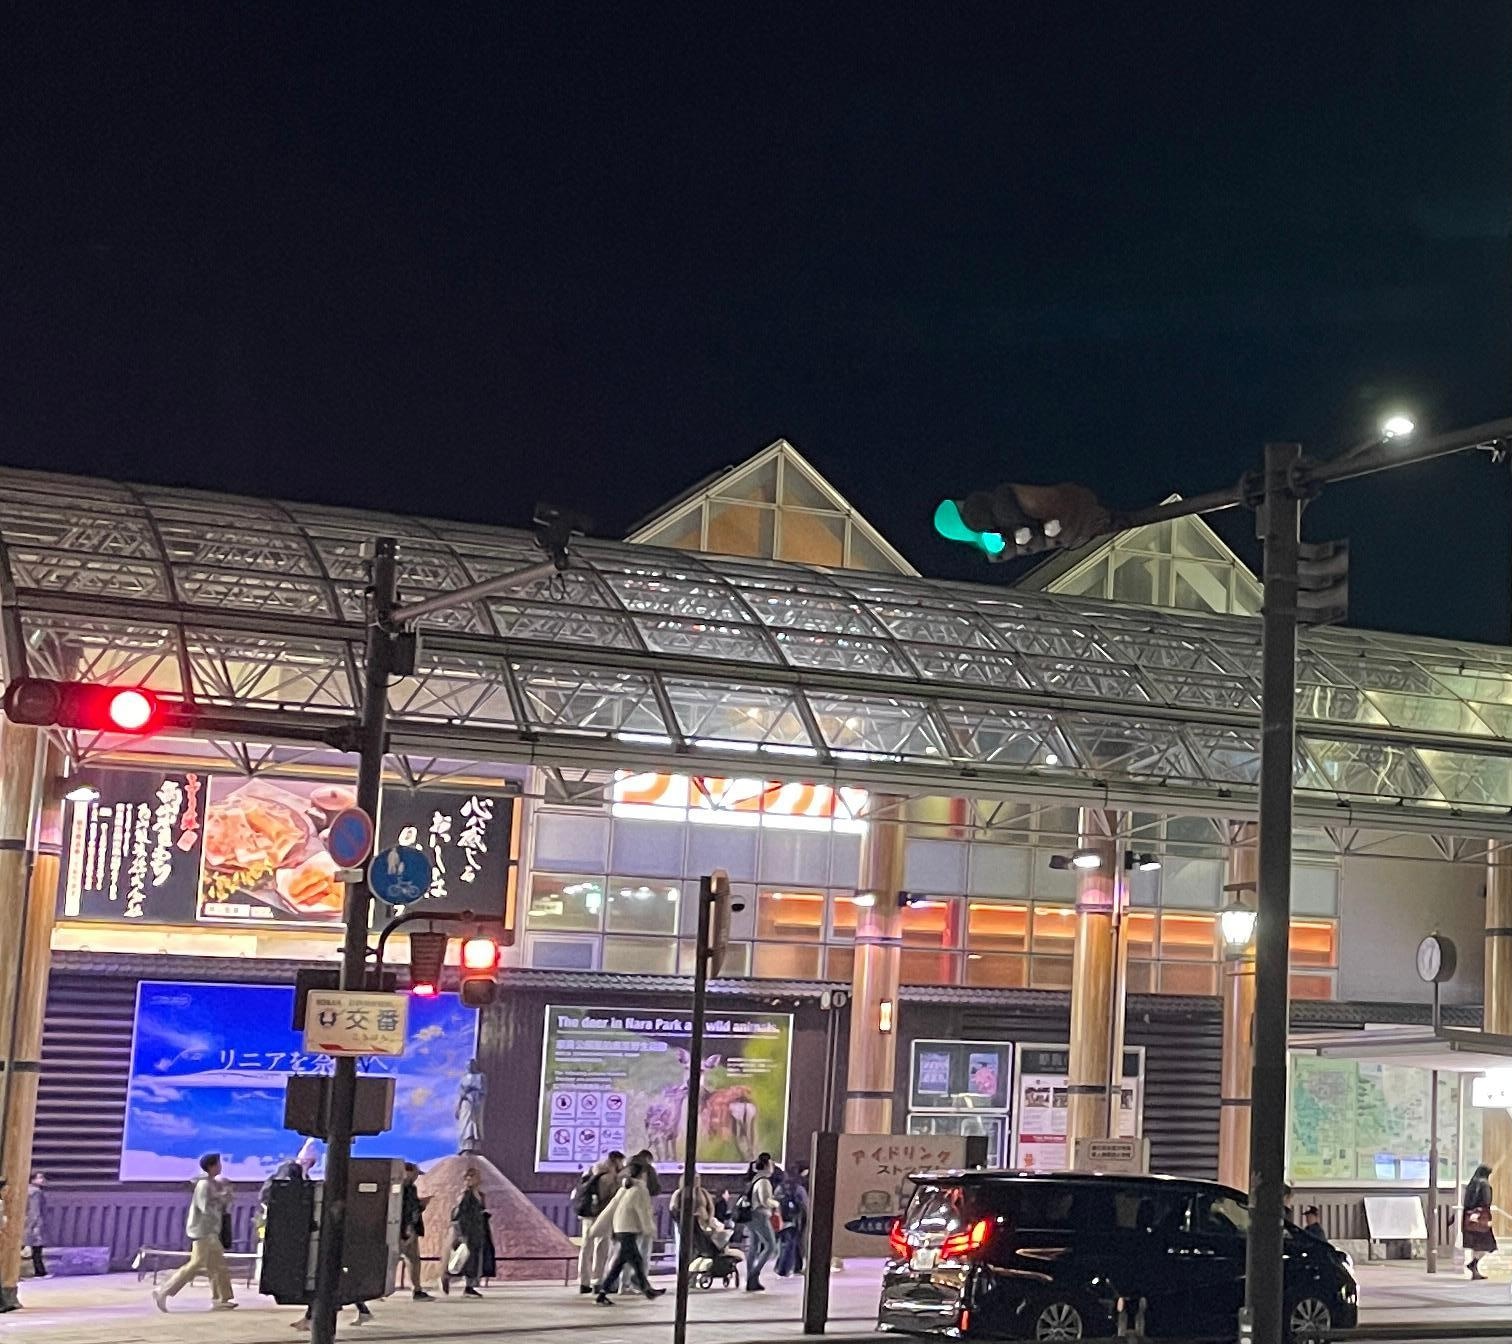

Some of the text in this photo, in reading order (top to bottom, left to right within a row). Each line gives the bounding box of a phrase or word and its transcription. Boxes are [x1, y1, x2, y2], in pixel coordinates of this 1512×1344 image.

[344, 1006, 399, 1032] 交番
[558, 1015, 579, 1028] The
[581, 1016, 608, 1029] deer
[611, 1017, 622, 1029] in
[655, 1018, 682, 1031] Park
[705, 1020, 730, 1032] wild
[219, 1047, 389, 1072] リニアを奈へ
[851, 1146, 950, 1165] アイドリング
